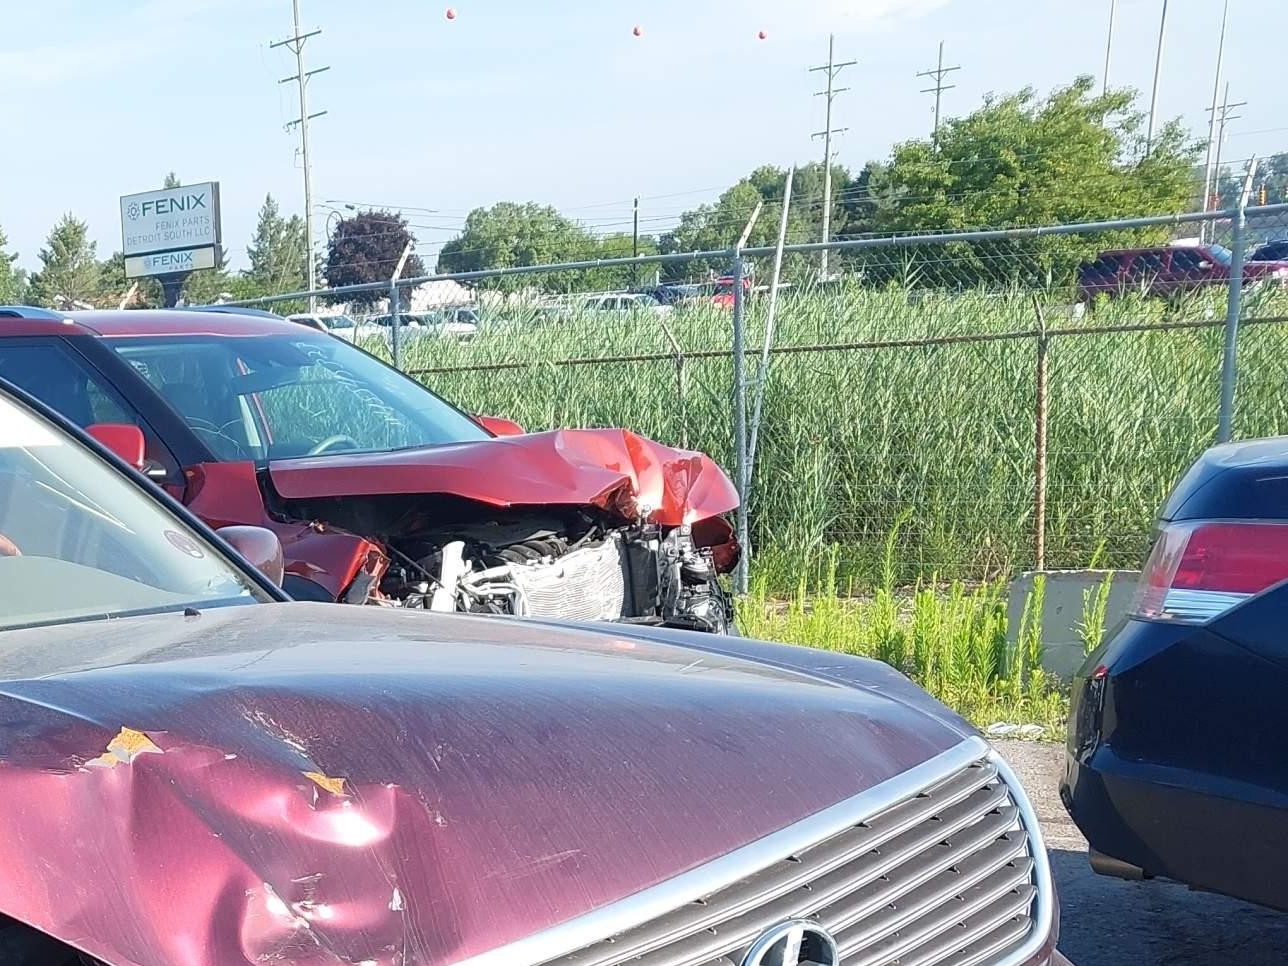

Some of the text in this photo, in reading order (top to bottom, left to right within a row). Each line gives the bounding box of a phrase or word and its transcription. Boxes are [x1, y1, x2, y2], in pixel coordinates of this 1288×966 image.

[142, 193, 206, 216] FENIX
[155, 215, 210, 231] FENIX PARTS
[127, 226, 211, 246] DETROIT SOUTH LLC
[152, 252, 193, 266] FENIX
